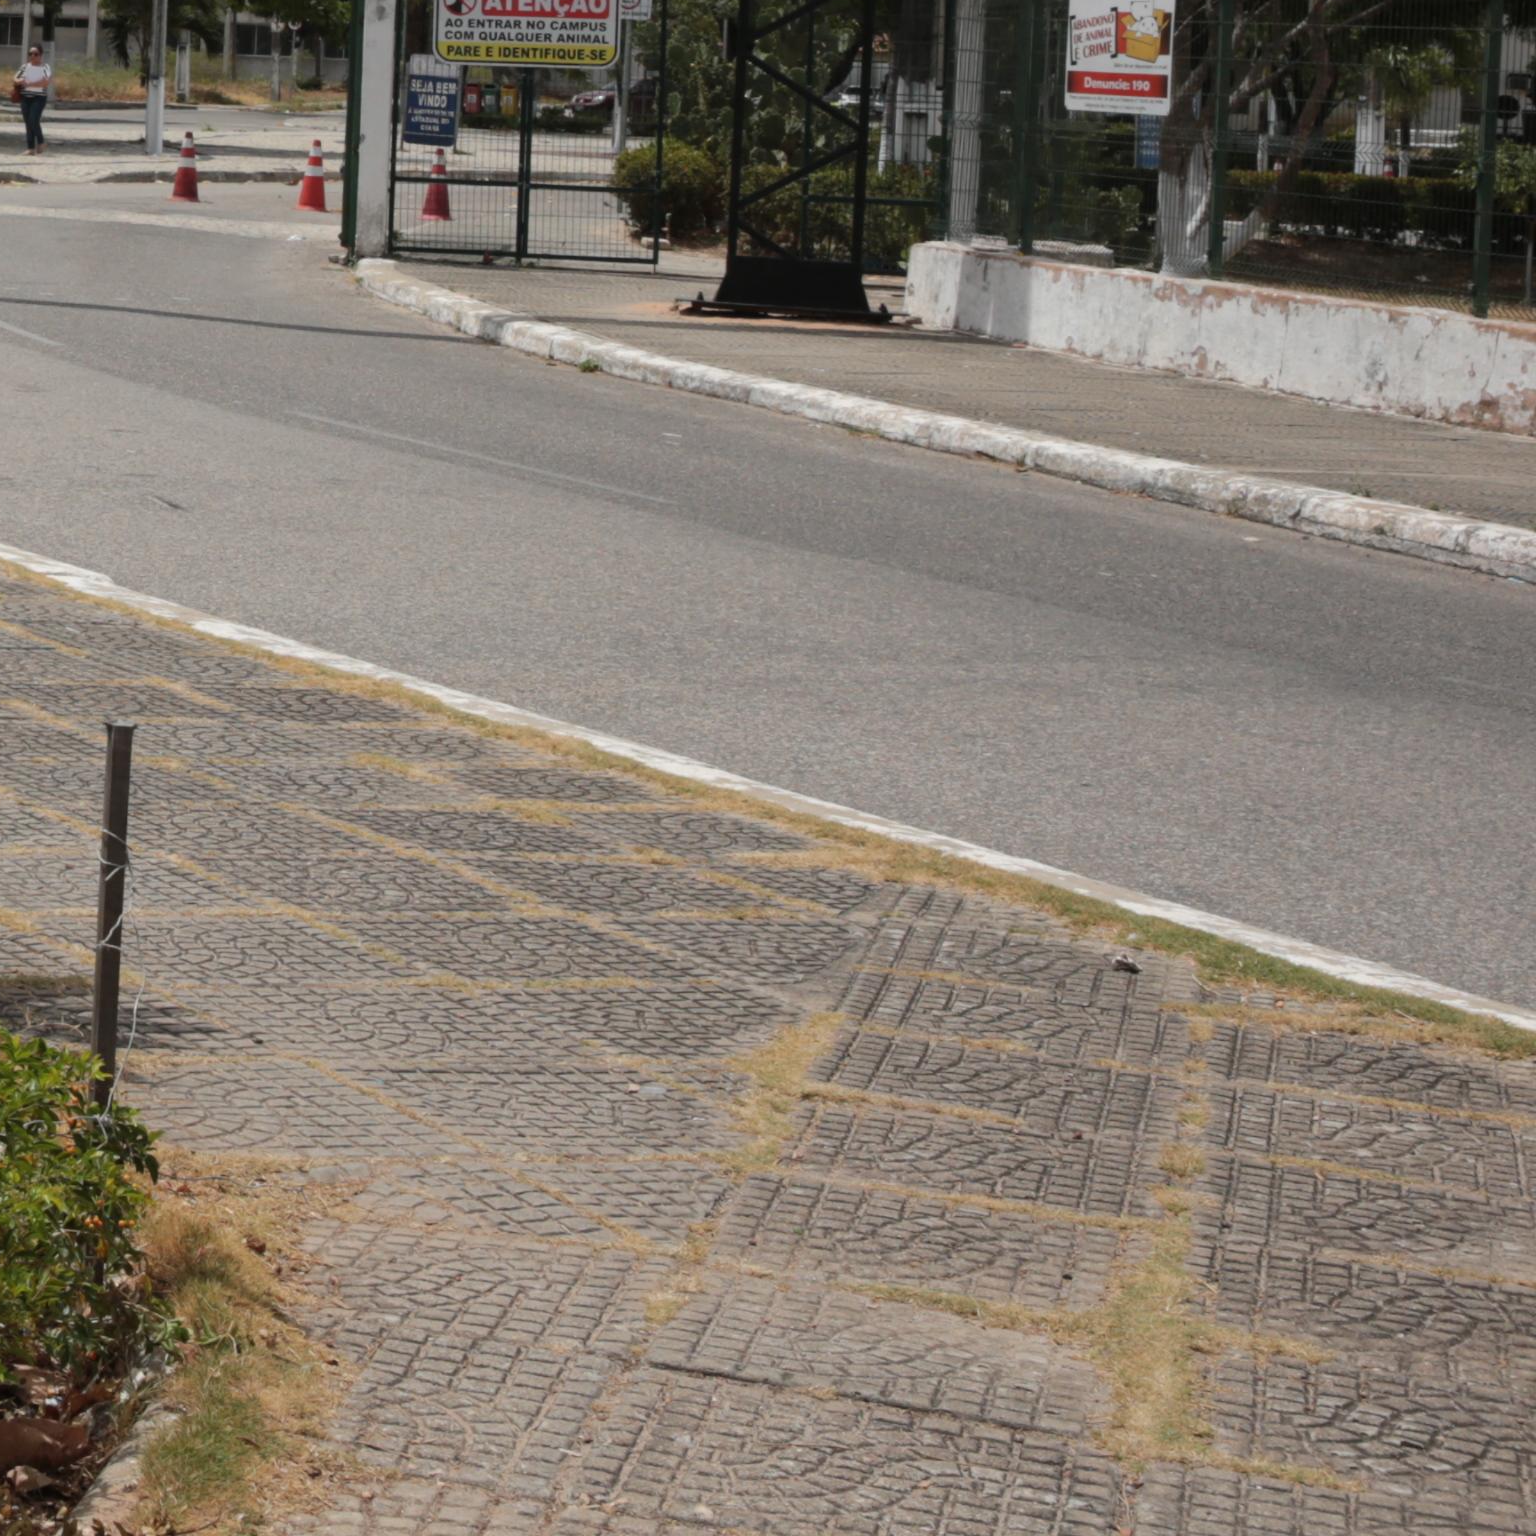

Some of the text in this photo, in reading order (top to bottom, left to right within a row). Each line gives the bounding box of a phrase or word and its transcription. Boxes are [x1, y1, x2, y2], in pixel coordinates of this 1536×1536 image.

[445, 18, 608, 32] AO ENTRAR NO CAMPUS
[1072, 14, 1114, 30] ABANDONO
[444, 30, 609, 44] COM QUALQUER ANIMAL
[1073, 27, 1112, 44] DE ANIMAL
[447, 45, 608, 61] PARE E IDENTIFIQUE-SE
[1083, 40, 1113, 58] CRIME
[410, 78, 457, 95] SEJA BEM
[1084, 76, 1150, 91] Denuncie: 190
[417, 94, 448, 108] VINDO
